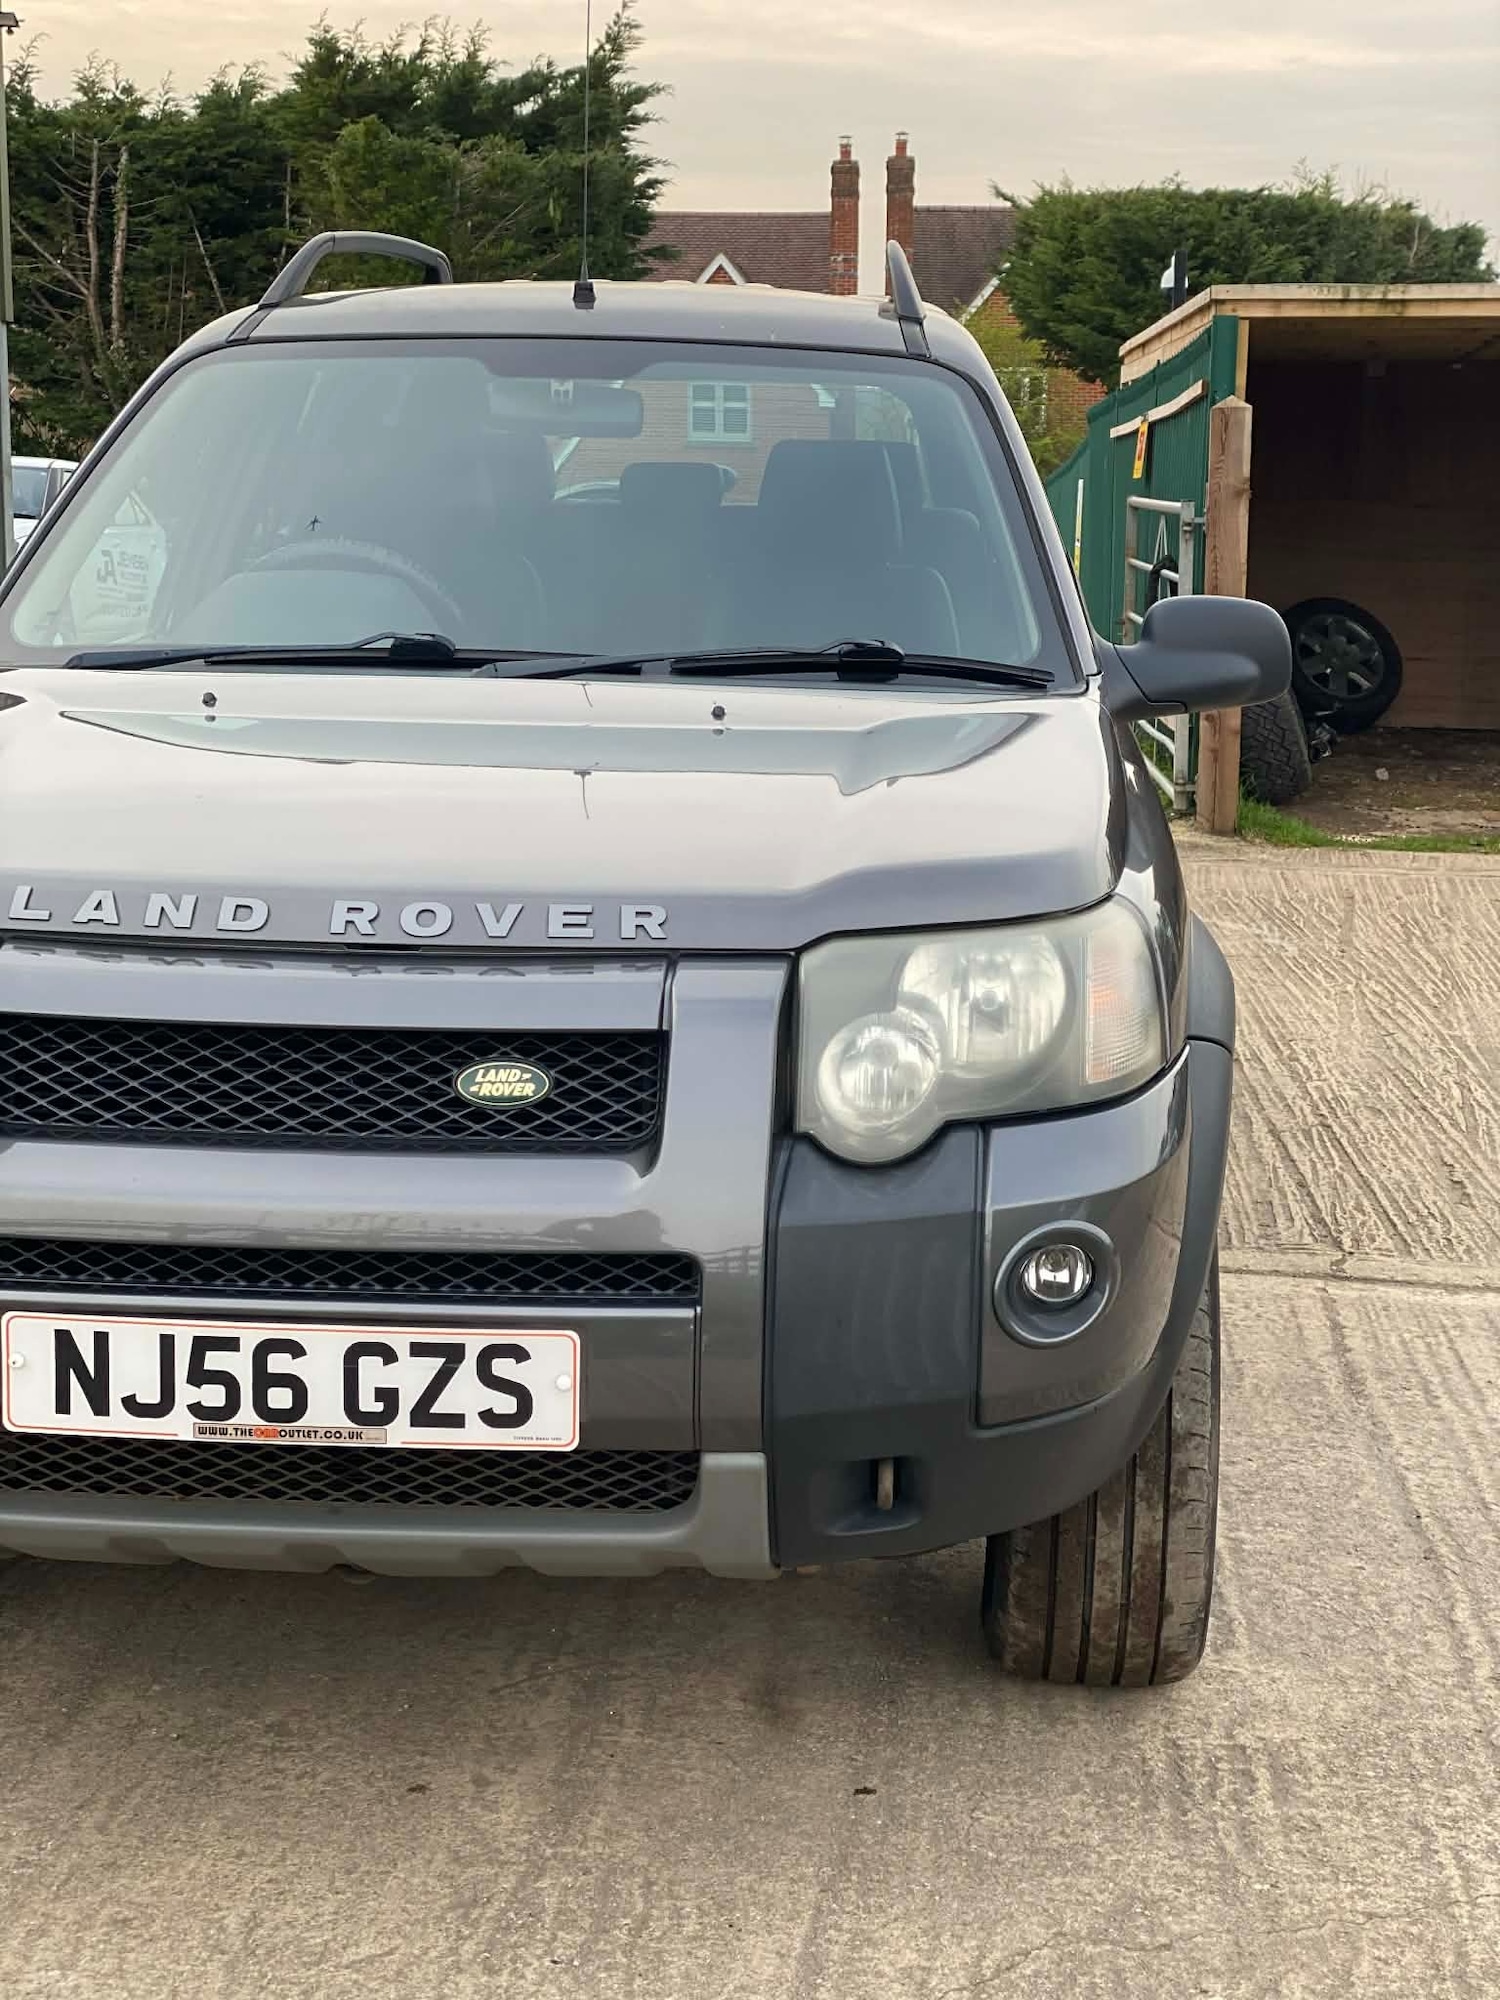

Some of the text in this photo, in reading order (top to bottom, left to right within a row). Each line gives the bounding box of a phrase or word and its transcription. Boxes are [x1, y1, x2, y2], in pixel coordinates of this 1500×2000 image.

[8, 885, 667, 939] LAND ROVER
[475, 1069, 521, 1082] LAND
[479, 1083, 535, 1096] ROVER
[54, 1329, 534, 1429] NJ56 GZS
